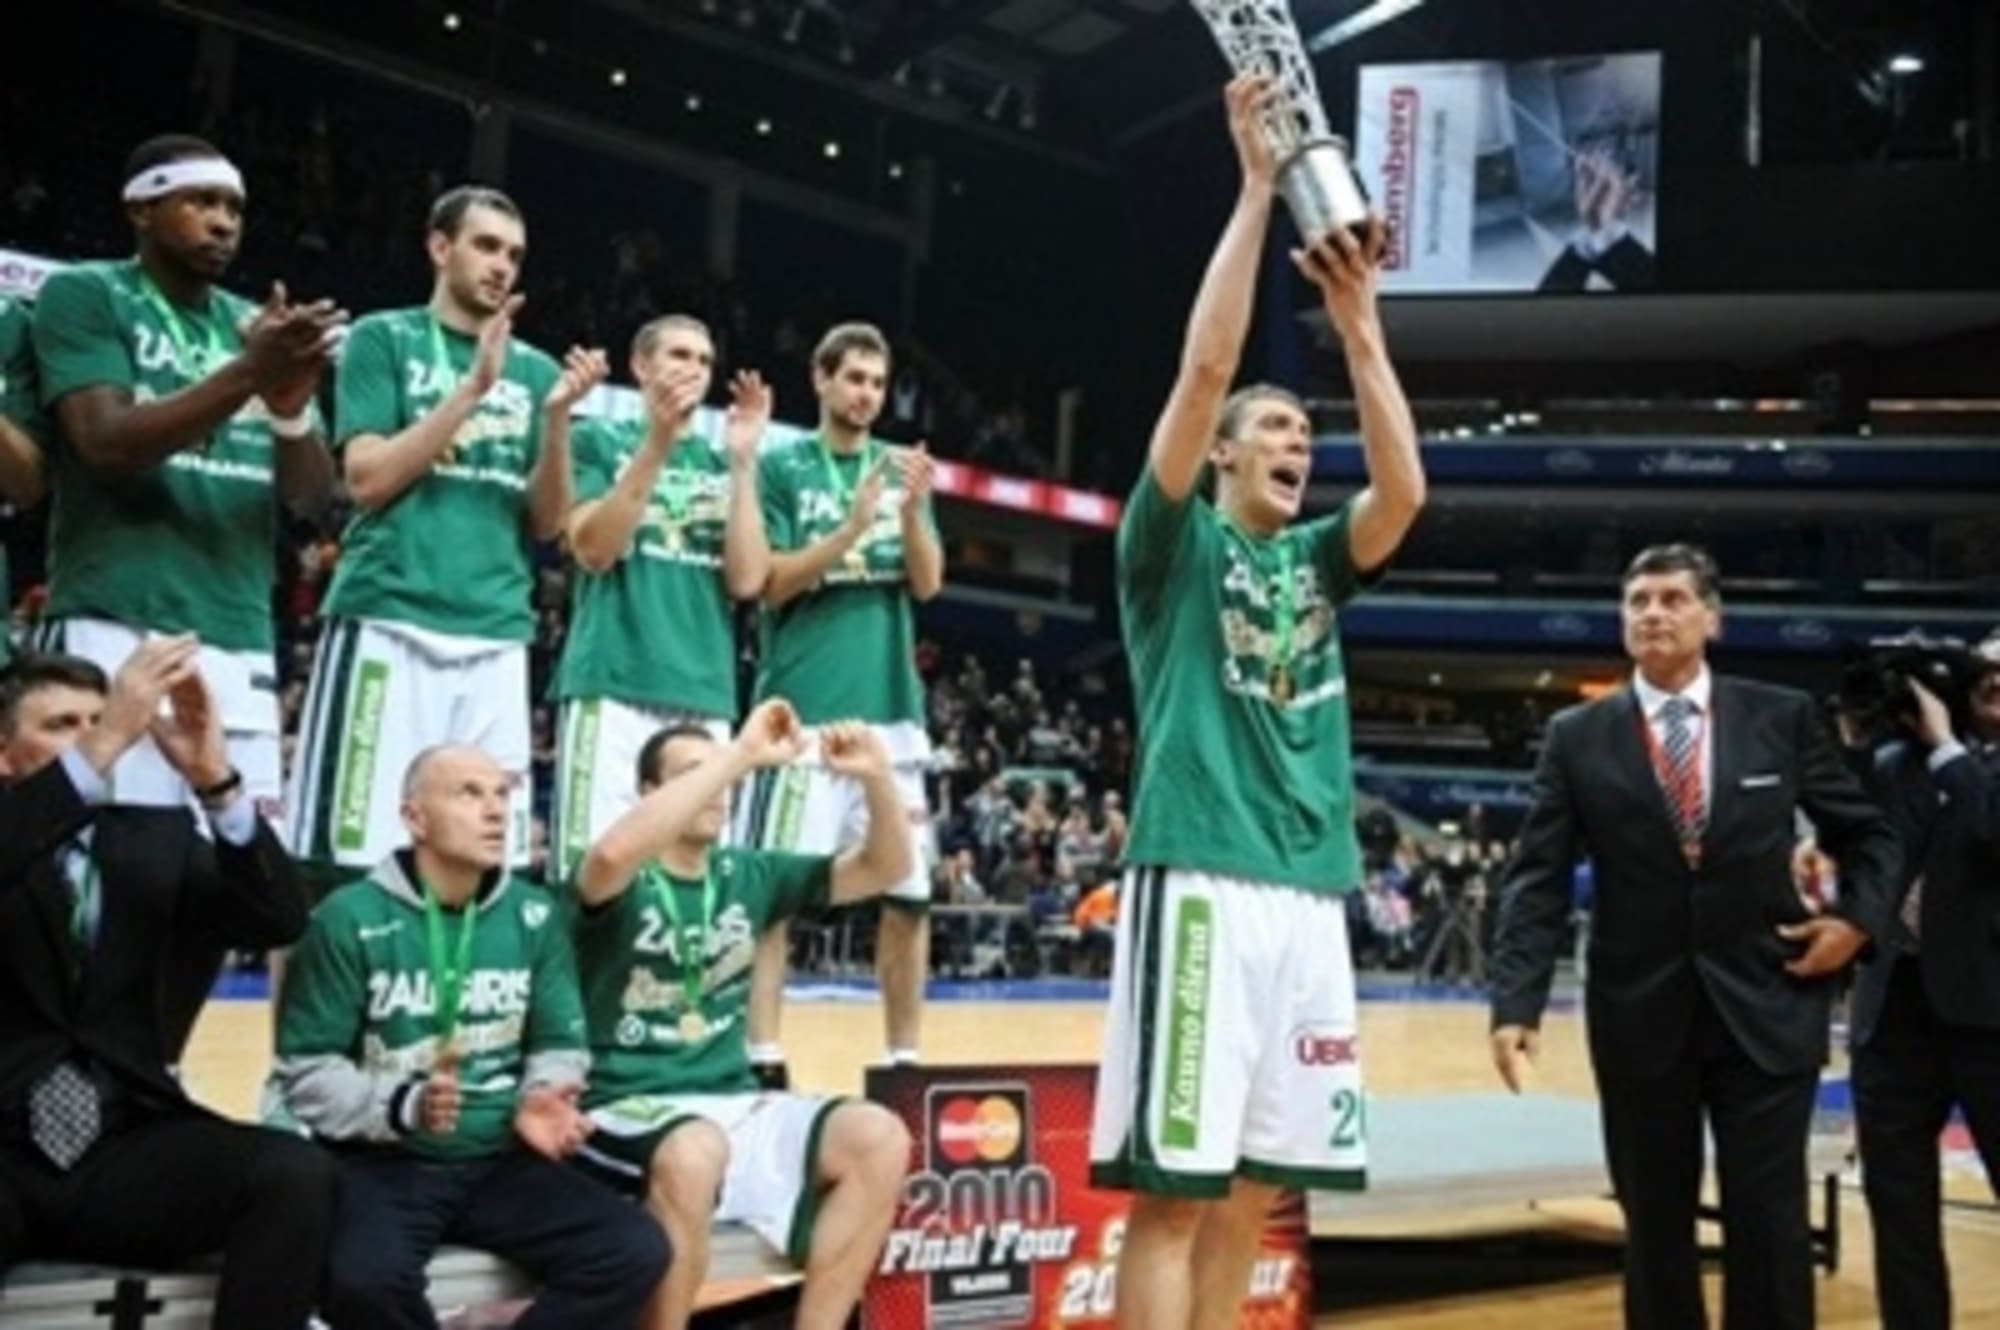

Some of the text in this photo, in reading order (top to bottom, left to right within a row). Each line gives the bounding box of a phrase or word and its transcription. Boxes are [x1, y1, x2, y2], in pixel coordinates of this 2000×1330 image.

[1167, 919, 1209, 1122] Kauno diena
[1330, 1088, 1366, 1147] 2
[904, 1167, 1053, 1232] 2010
[881, 1227, 986, 1274] Final
[990, 1223, 1076, 1263] Four
